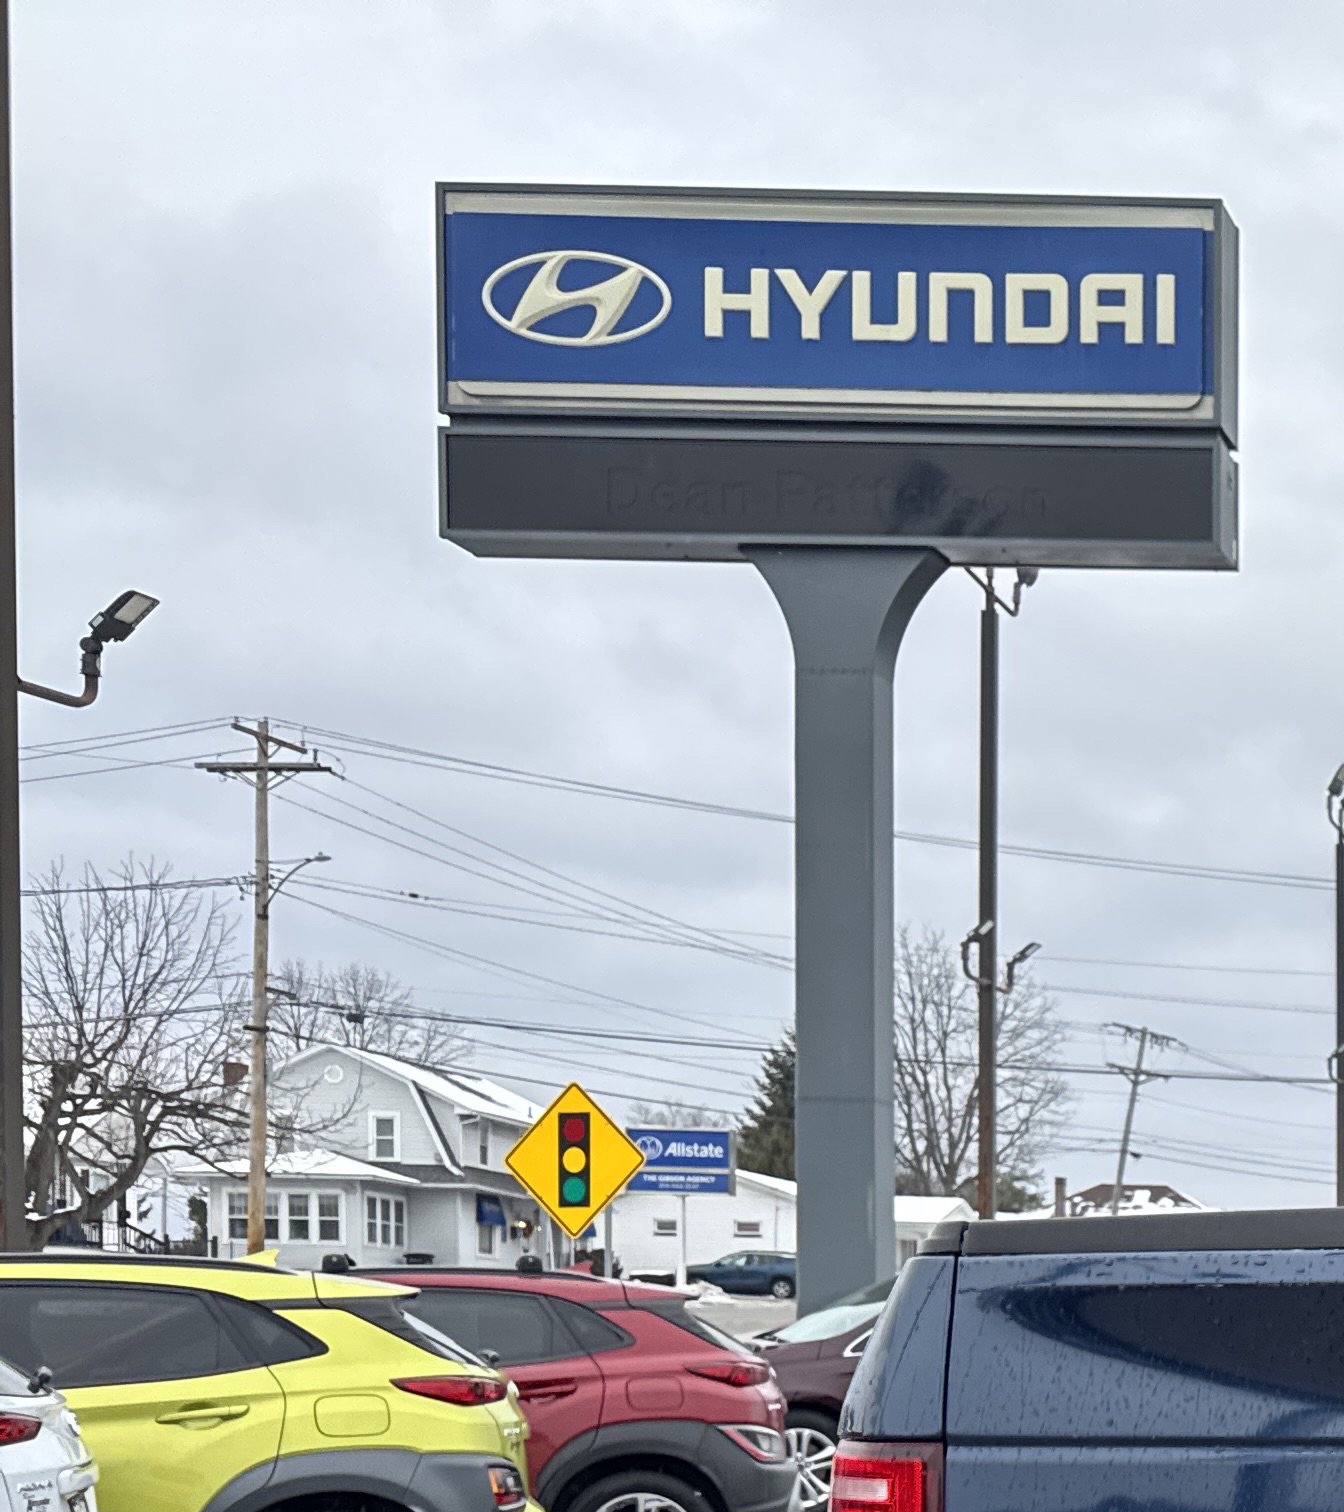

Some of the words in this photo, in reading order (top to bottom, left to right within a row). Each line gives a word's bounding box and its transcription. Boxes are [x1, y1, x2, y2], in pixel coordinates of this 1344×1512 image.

[704, 267, 1176, 346] HYUNDAI
[776, 470, 1048, 521] Patteon
[664, 1142, 724, 1159] Allstate
